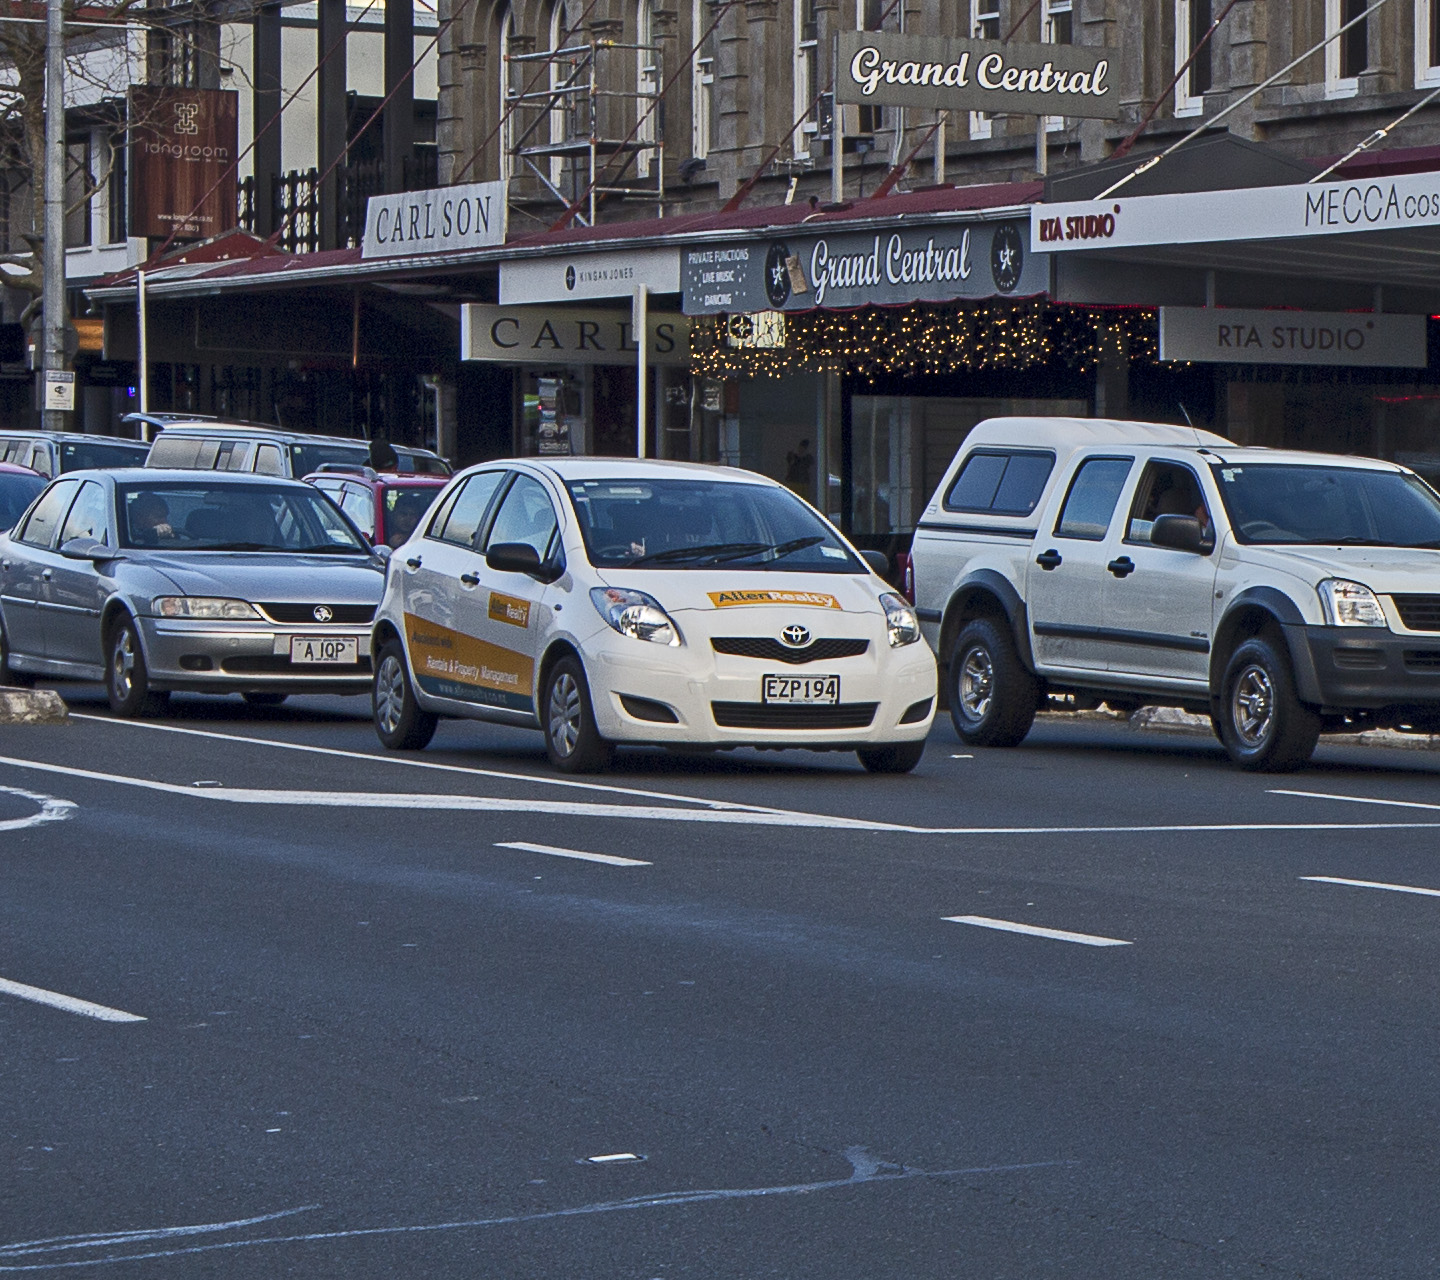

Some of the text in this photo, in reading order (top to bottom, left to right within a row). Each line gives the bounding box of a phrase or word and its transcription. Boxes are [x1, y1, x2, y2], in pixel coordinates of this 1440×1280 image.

[851, 47, 1109, 96] Grand Central
[376, 195, 491, 244] CARLSON
[1305, 183, 1400, 227] MECCA
[1040, 213, 1115, 242] RTA STUDIO
[609, 267, 633, 280] JONES
[810, 235, 881, 305] Grand
[886, 228, 972, 285] Central
[1218, 325, 1365, 351] RTA STUDIO
[719, 592, 833, 607] AllenRealty
[767, 680, 836, 699] EZP194
